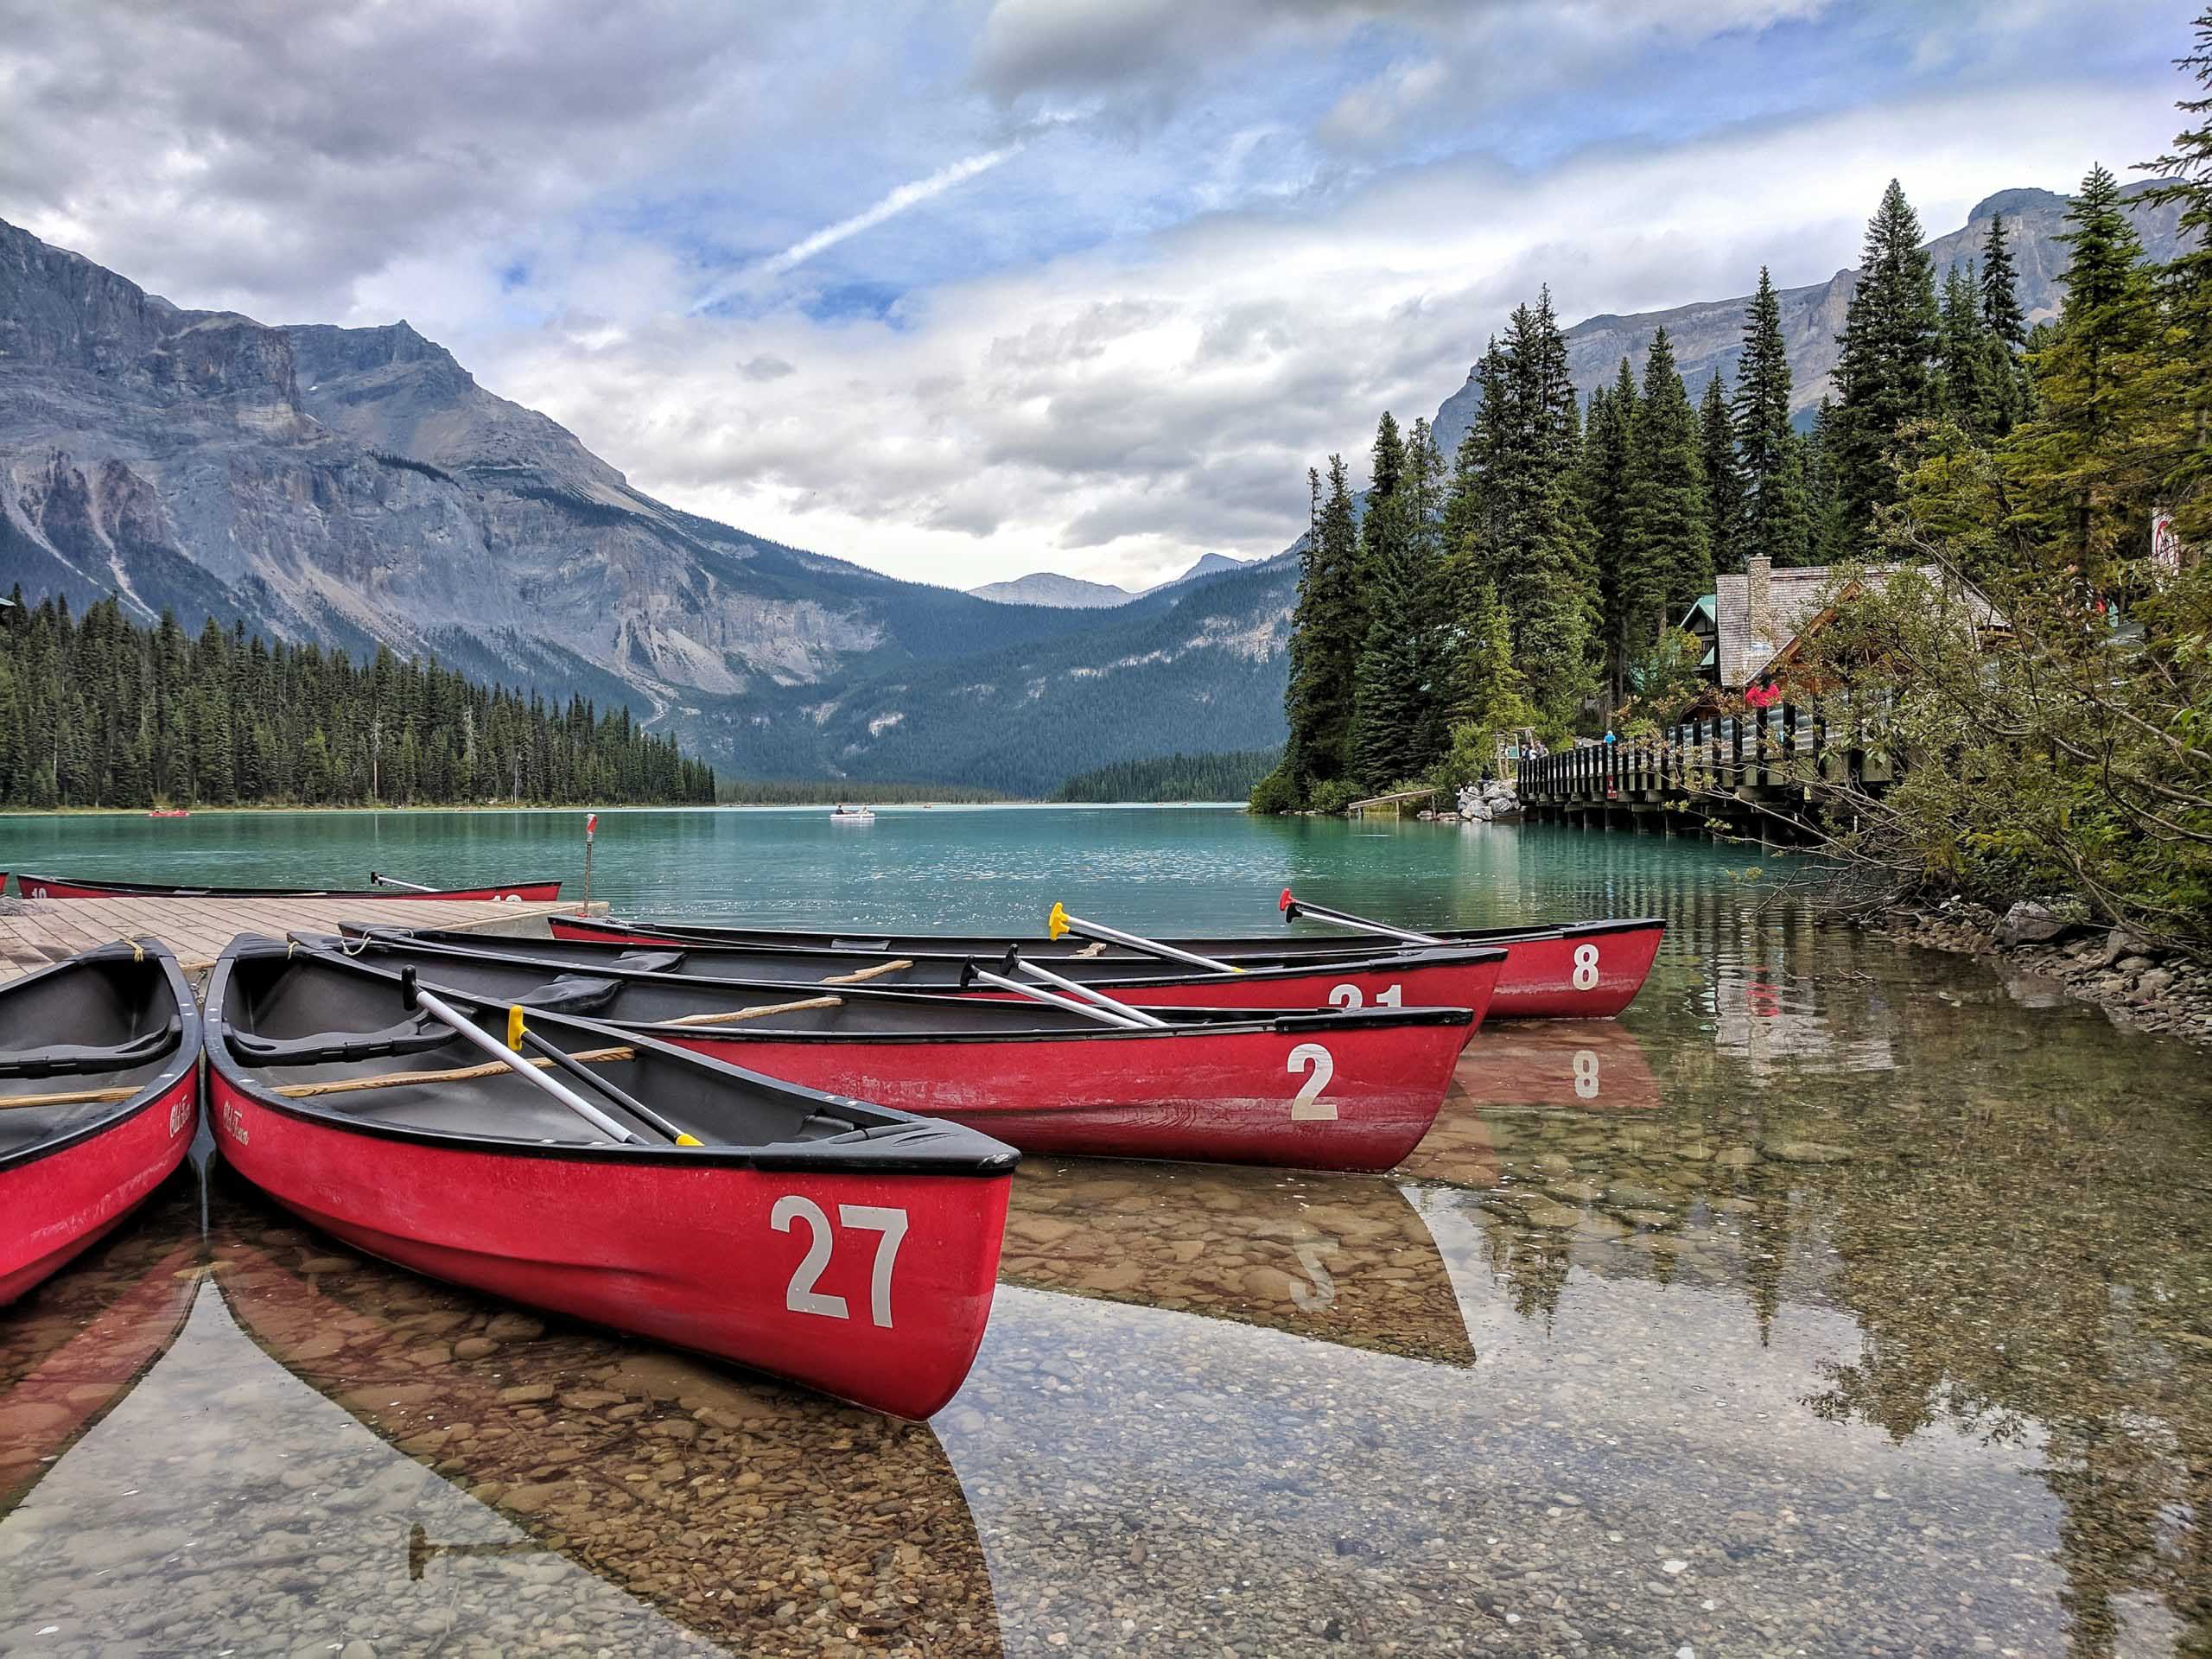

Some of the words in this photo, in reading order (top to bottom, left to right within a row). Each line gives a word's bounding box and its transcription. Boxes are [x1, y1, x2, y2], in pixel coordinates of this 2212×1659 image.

[1573, 944, 1599, 990] 8
[1287, 1043, 1338, 1121] 2
[771, 1195, 908, 1328] 27
